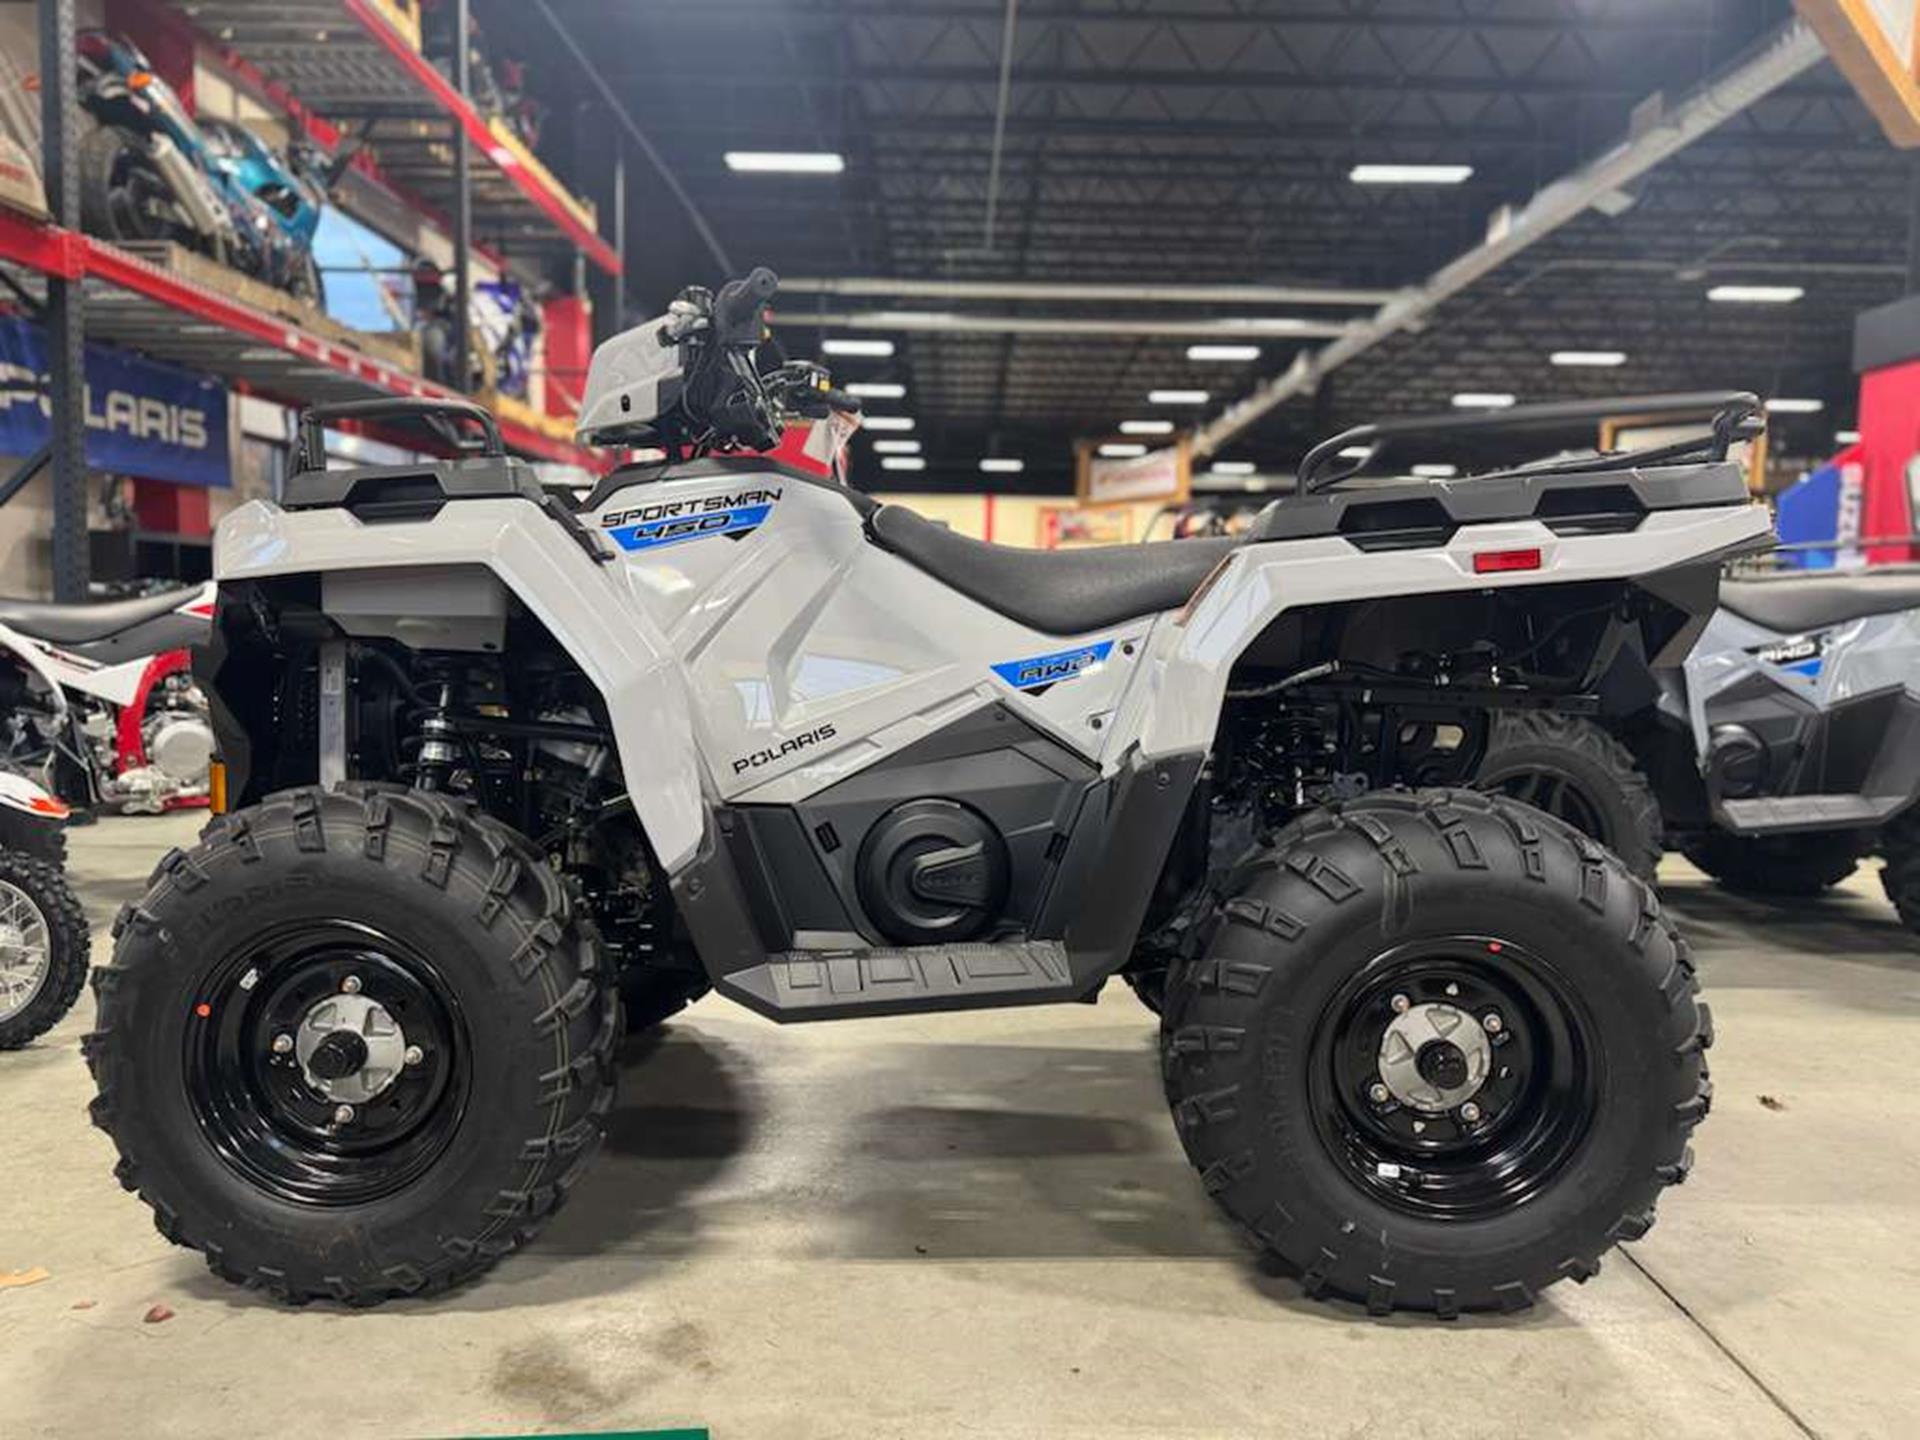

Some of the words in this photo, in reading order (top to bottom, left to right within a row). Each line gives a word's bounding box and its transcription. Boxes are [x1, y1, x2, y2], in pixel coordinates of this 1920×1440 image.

[601, 488, 783, 527] SPORTSMAN
[635, 515, 731, 540] 450
[731, 723, 837, 775] POLARIS
